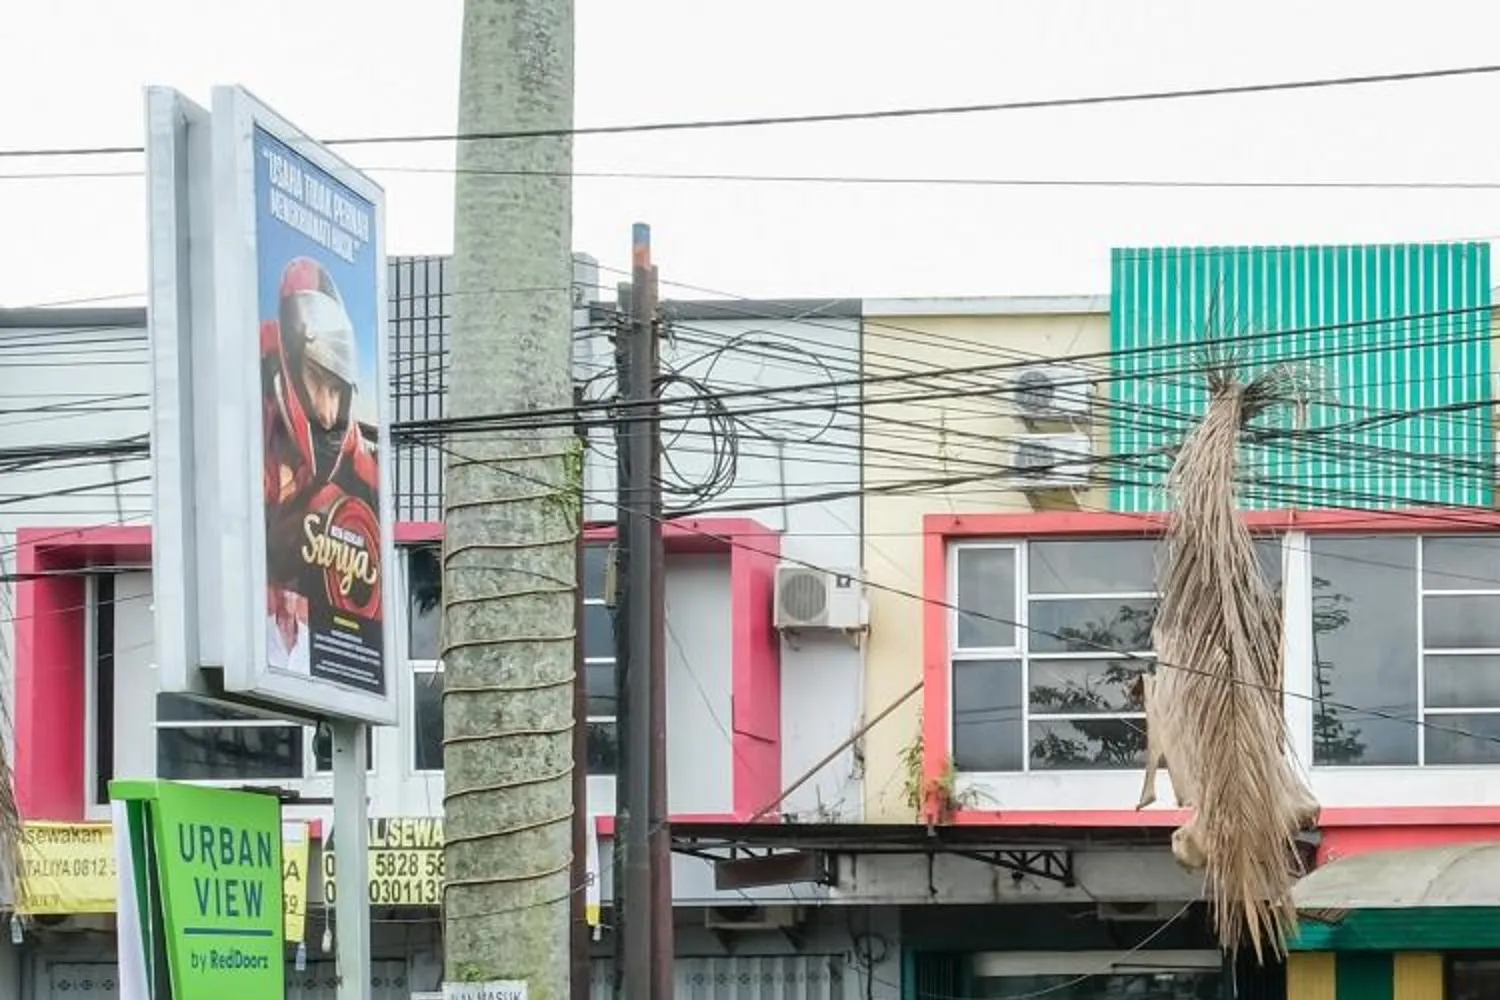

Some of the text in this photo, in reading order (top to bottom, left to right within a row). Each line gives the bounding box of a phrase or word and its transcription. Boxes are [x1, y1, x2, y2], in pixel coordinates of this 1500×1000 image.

[302, 513, 377, 596] Surya
[179, 823, 272, 871] URBAN
[376, 854, 419, 876] 5828
[194, 876, 263, 918] VIEW
[191, 949, 269, 973] by RedDoorz
